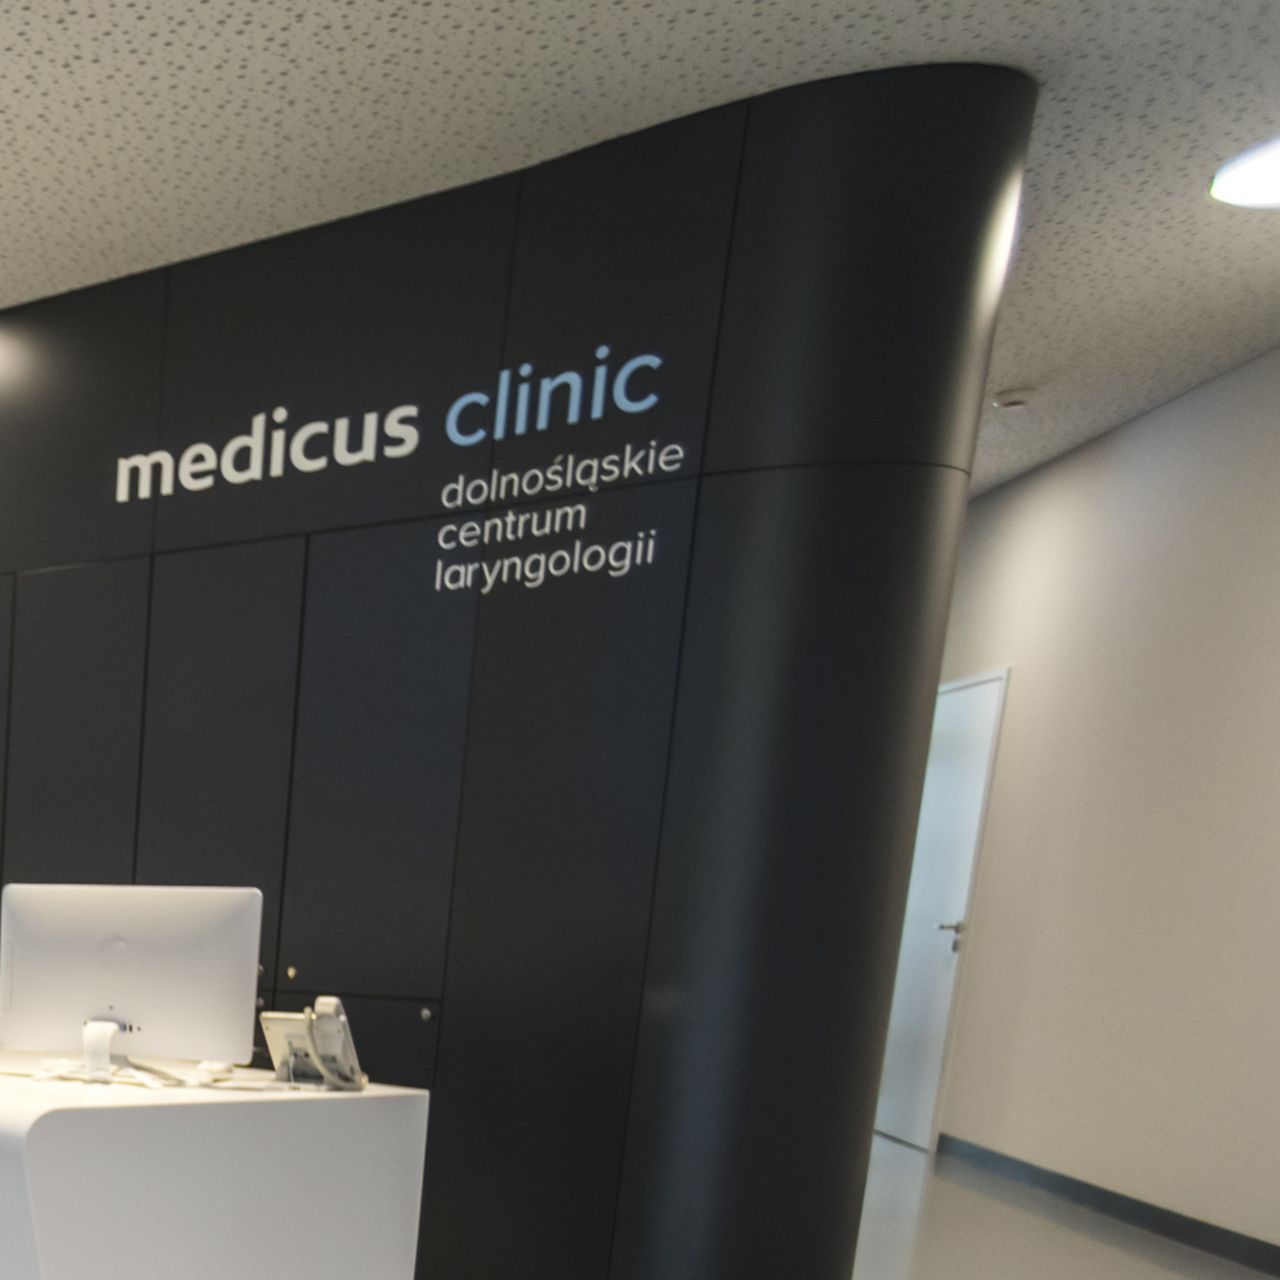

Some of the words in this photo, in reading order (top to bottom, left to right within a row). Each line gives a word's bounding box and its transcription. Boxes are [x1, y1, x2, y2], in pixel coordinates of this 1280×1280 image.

[116, 404, 420, 503] medicus
[445, 345, 664, 447] clinic
[441, 440, 685, 509] dolnośląskie
[437, 503, 587, 550] centrum
[434, 529, 656, 595] laryngologii
